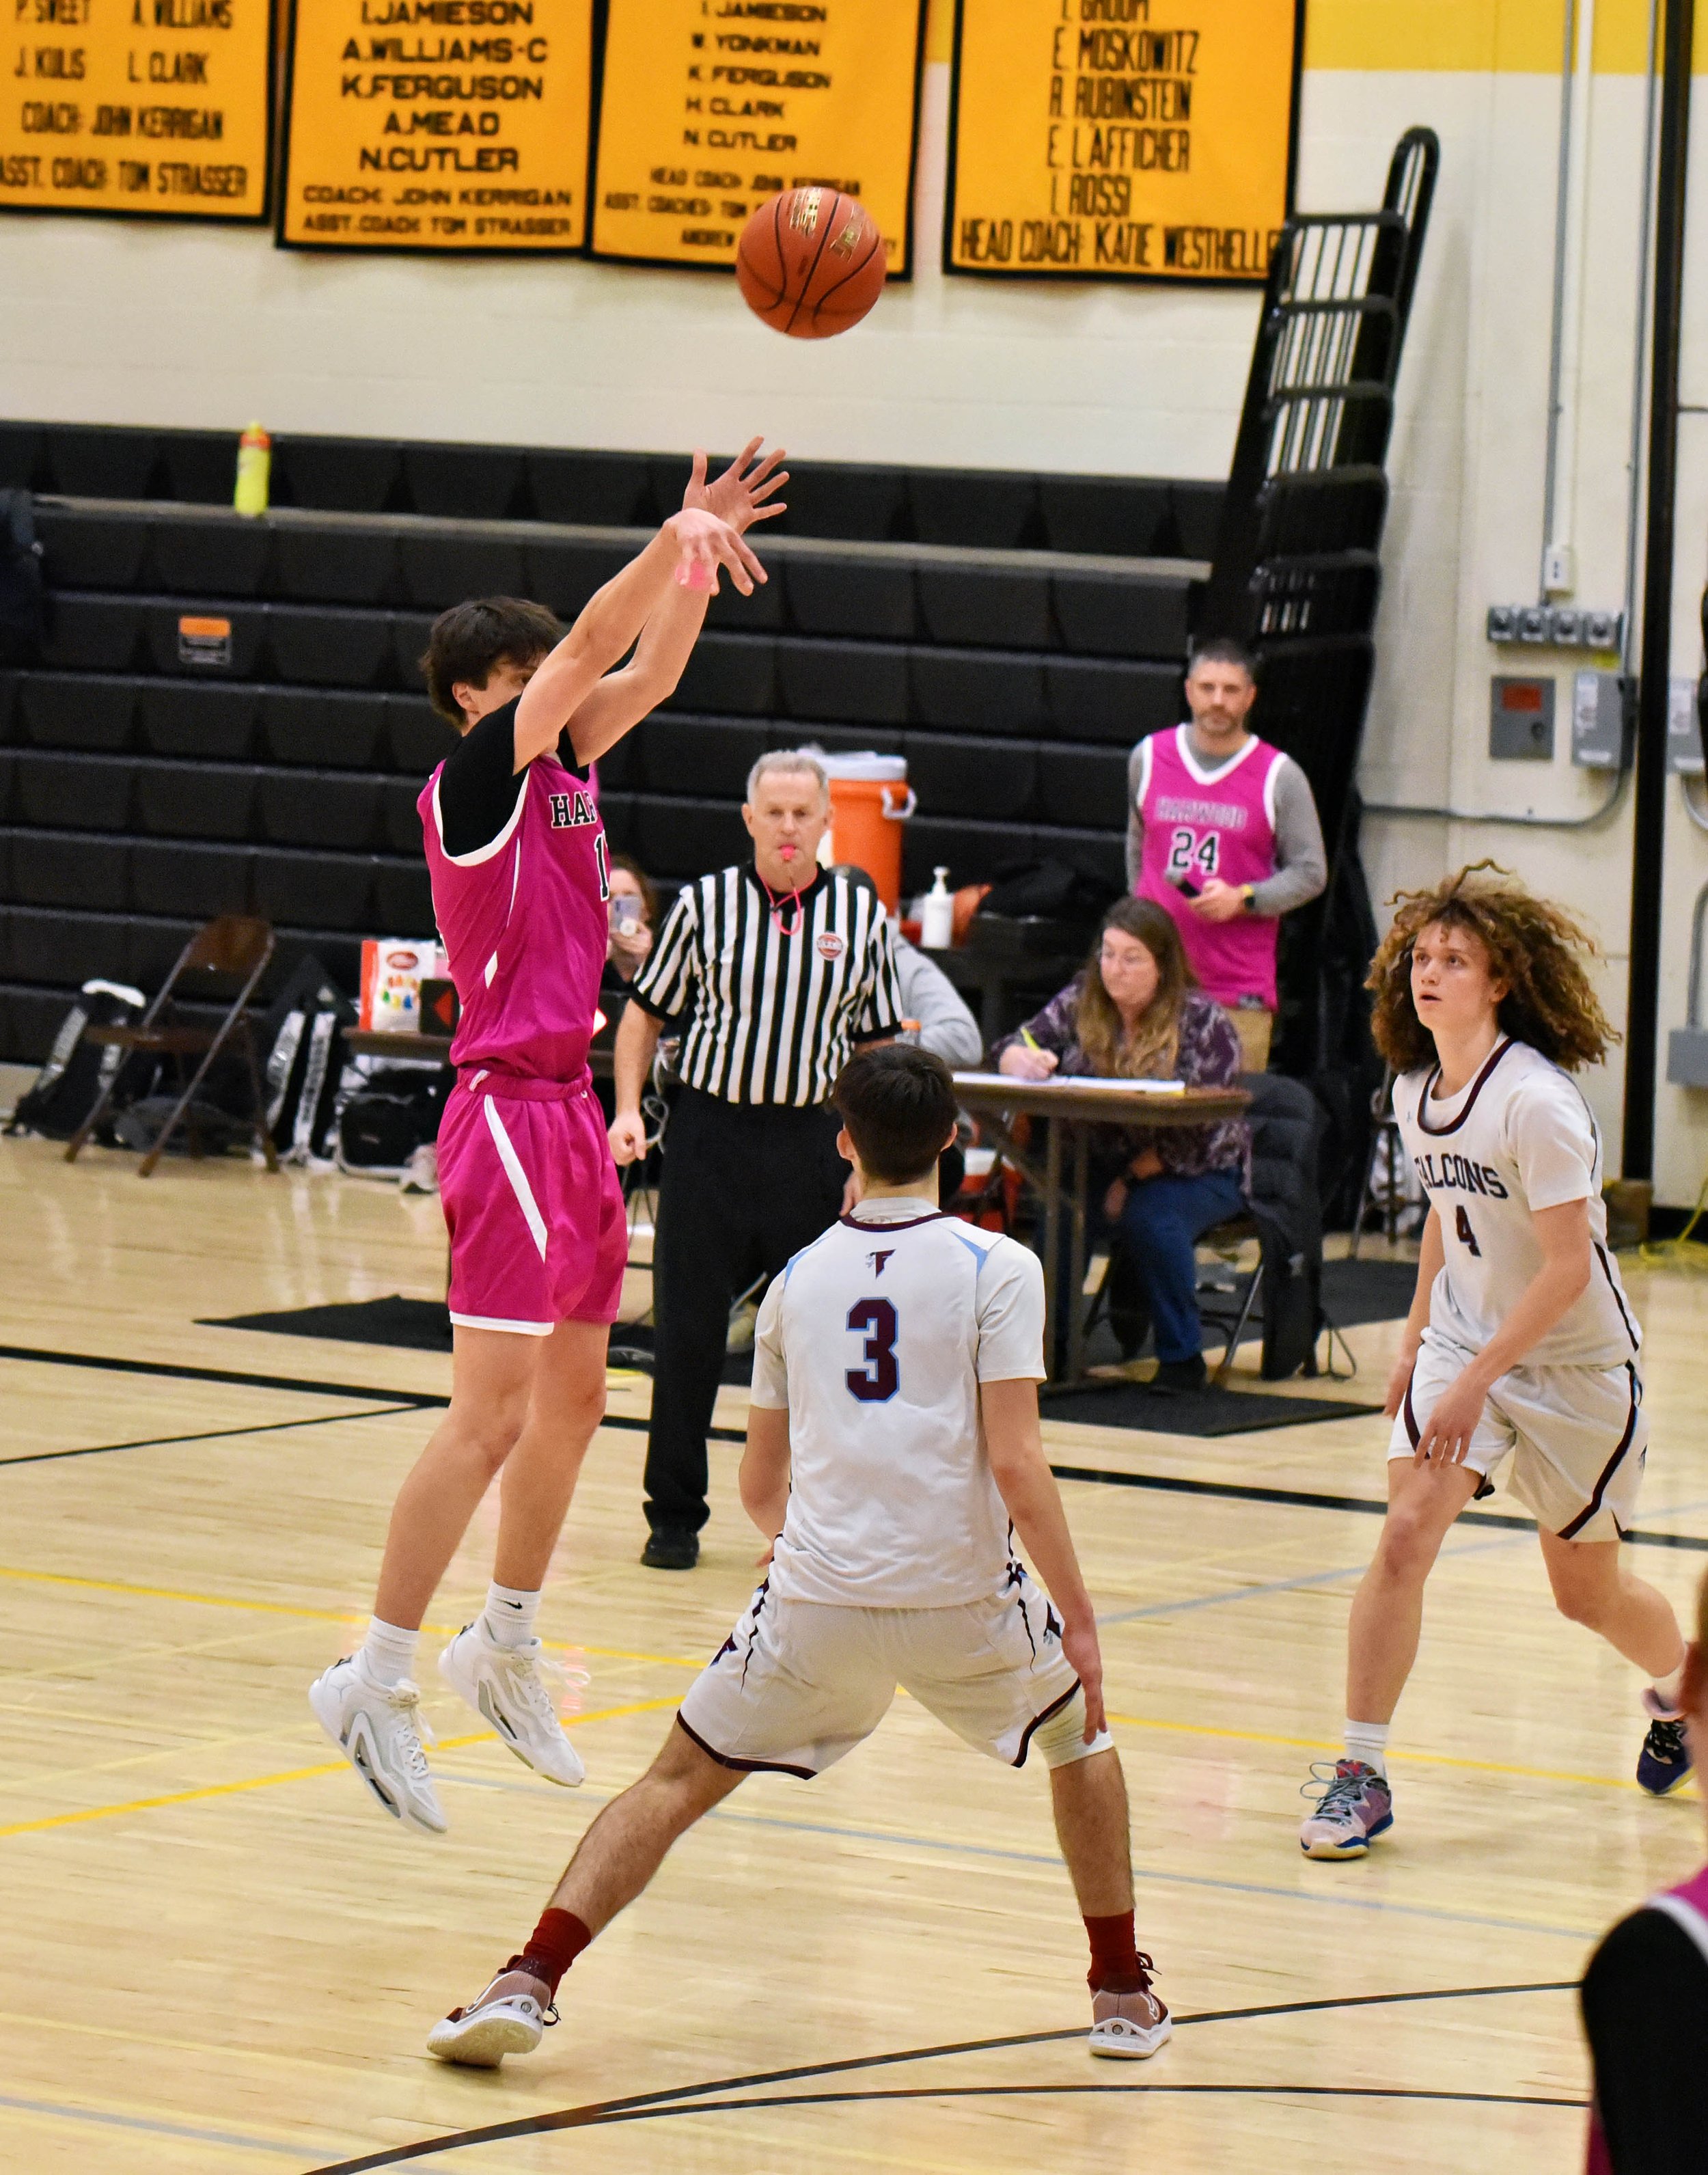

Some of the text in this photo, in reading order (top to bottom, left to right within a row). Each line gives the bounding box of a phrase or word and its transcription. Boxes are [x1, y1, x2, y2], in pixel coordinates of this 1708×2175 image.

[1069, 173, 1132, 217] ROSSI
[960, 218, 1013, 262] HEAD
[1094, 221, 1153, 267] KATIE
[1169, 827, 1220, 877] 24
[1455, 1205, 1482, 1258] 4
[844, 1296, 900, 1404] 3
